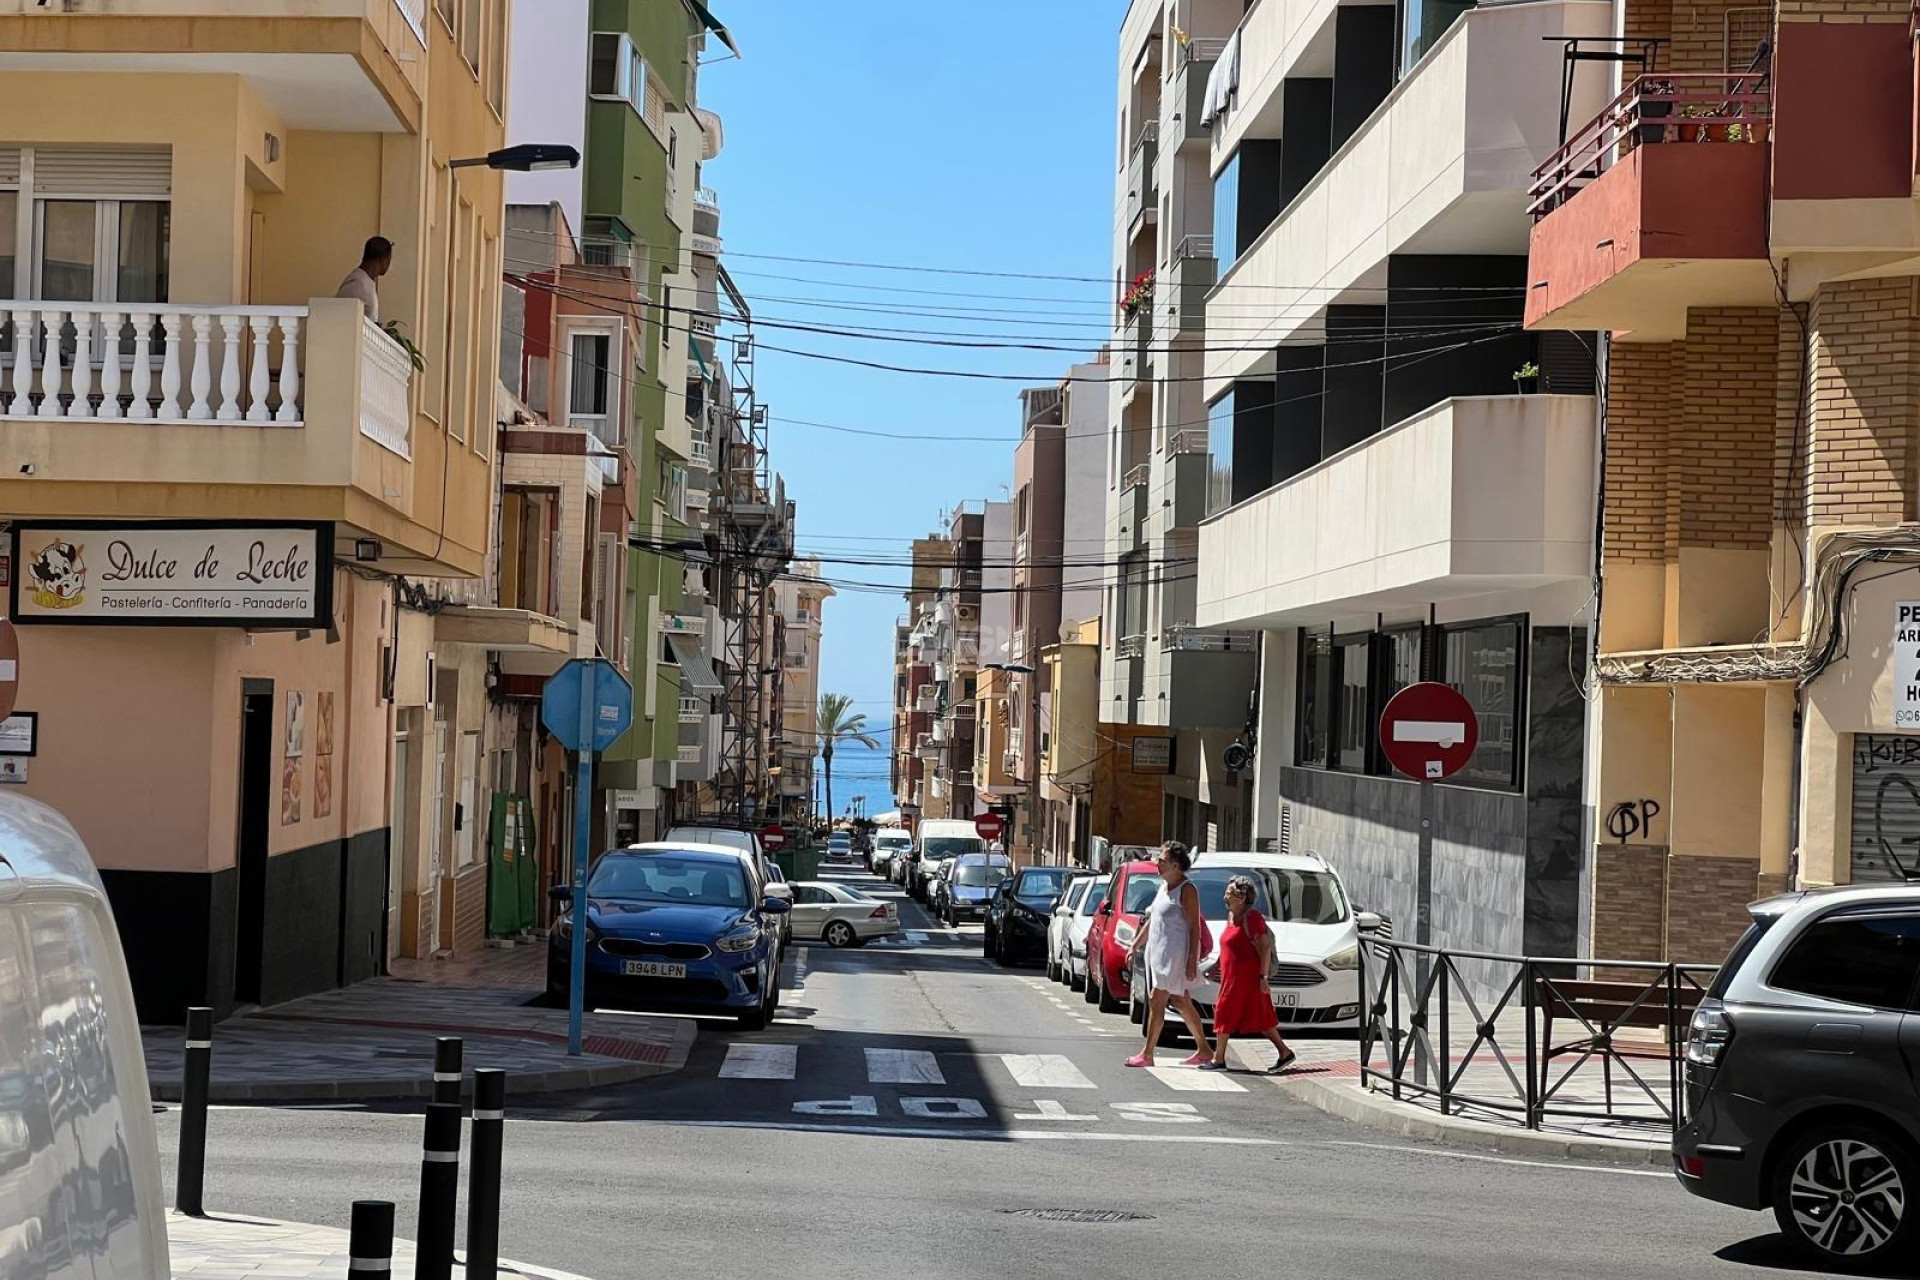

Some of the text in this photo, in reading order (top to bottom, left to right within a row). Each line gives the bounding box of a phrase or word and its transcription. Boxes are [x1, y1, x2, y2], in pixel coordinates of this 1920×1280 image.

[102, 540, 309, 585] Dulce de Leche
[101, 596, 162, 609] Pastelería
[172, 596, 231, 609] Confitería
[243, 596, 307, 609] Panadería
[660, 964, 684, 977] LPN
[791, 1095, 1212, 1122] STOP
